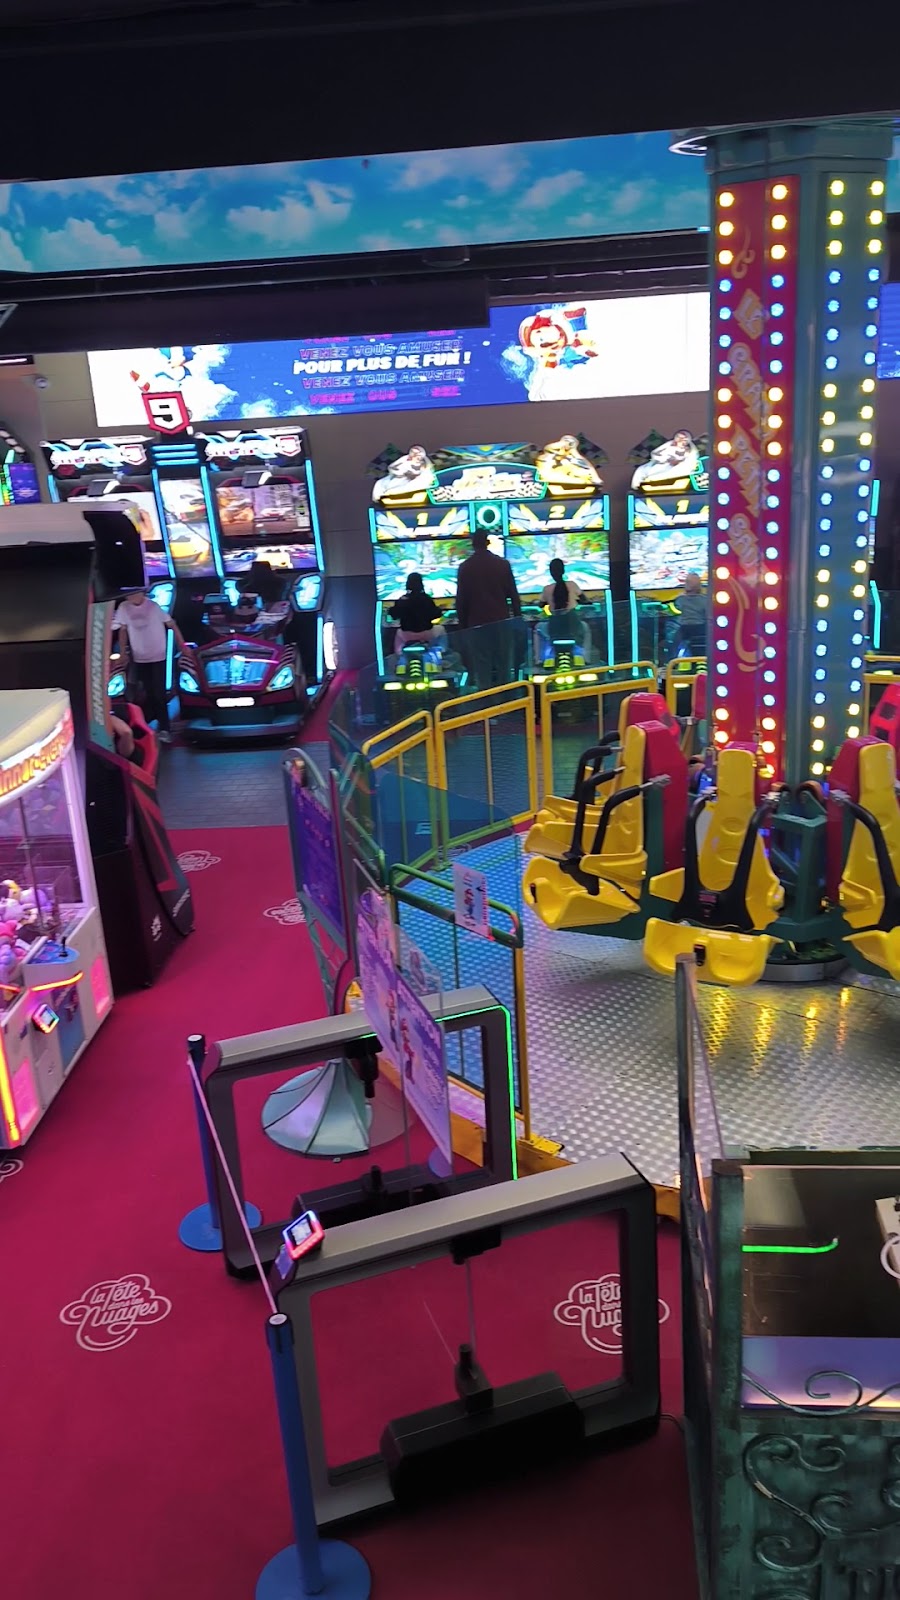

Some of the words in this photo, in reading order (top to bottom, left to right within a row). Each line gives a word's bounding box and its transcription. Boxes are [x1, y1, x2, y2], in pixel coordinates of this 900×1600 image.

[299, 346, 349, 360] VENEZ
[352, 342, 397, 357] VOUS
[397, 339, 463, 355] AMUSER
[293, 359, 343, 375] POUR
[346, 356, 392, 372] PLUS
[395, 354, 421, 369] DE
[422, 352, 460, 367] FUN
[302, 375, 352, 389] VENEZ
[354, 372, 398, 386] VOUS
[148, 398, 183, 429] 9
[549, 504, 566, 519] 2
[677, 499, 690, 513] 1
[417, 512, 429, 526] 1
[90, 1288, 106, 1304] la
[101, 1281, 142, 1312] Tête
[579, 1288, 595, 1305] la
[107, 1300, 130, 1311] dans
[84, 1301, 159, 1328] Nuages
